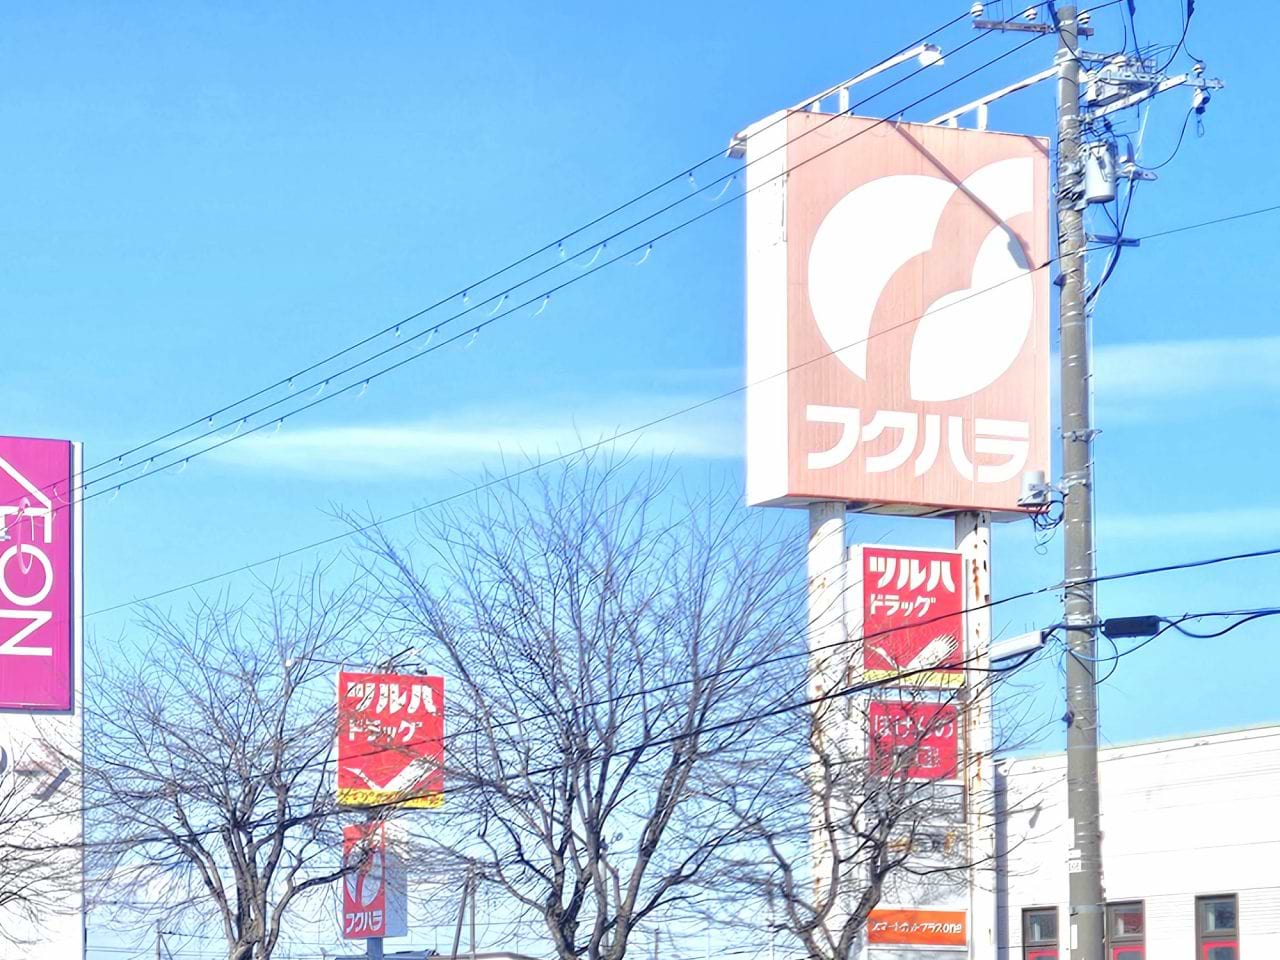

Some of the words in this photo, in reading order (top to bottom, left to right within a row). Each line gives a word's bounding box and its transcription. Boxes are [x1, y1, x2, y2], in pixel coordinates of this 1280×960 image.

[806, 404, 1030, 484] フクハラ
[869, 556, 956, 593] ツルハ
[870, 593, 937, 618] ドラッグ
[346, 681, 438, 717] ツルハ
[345, 910, 383, 935] フクハラ
